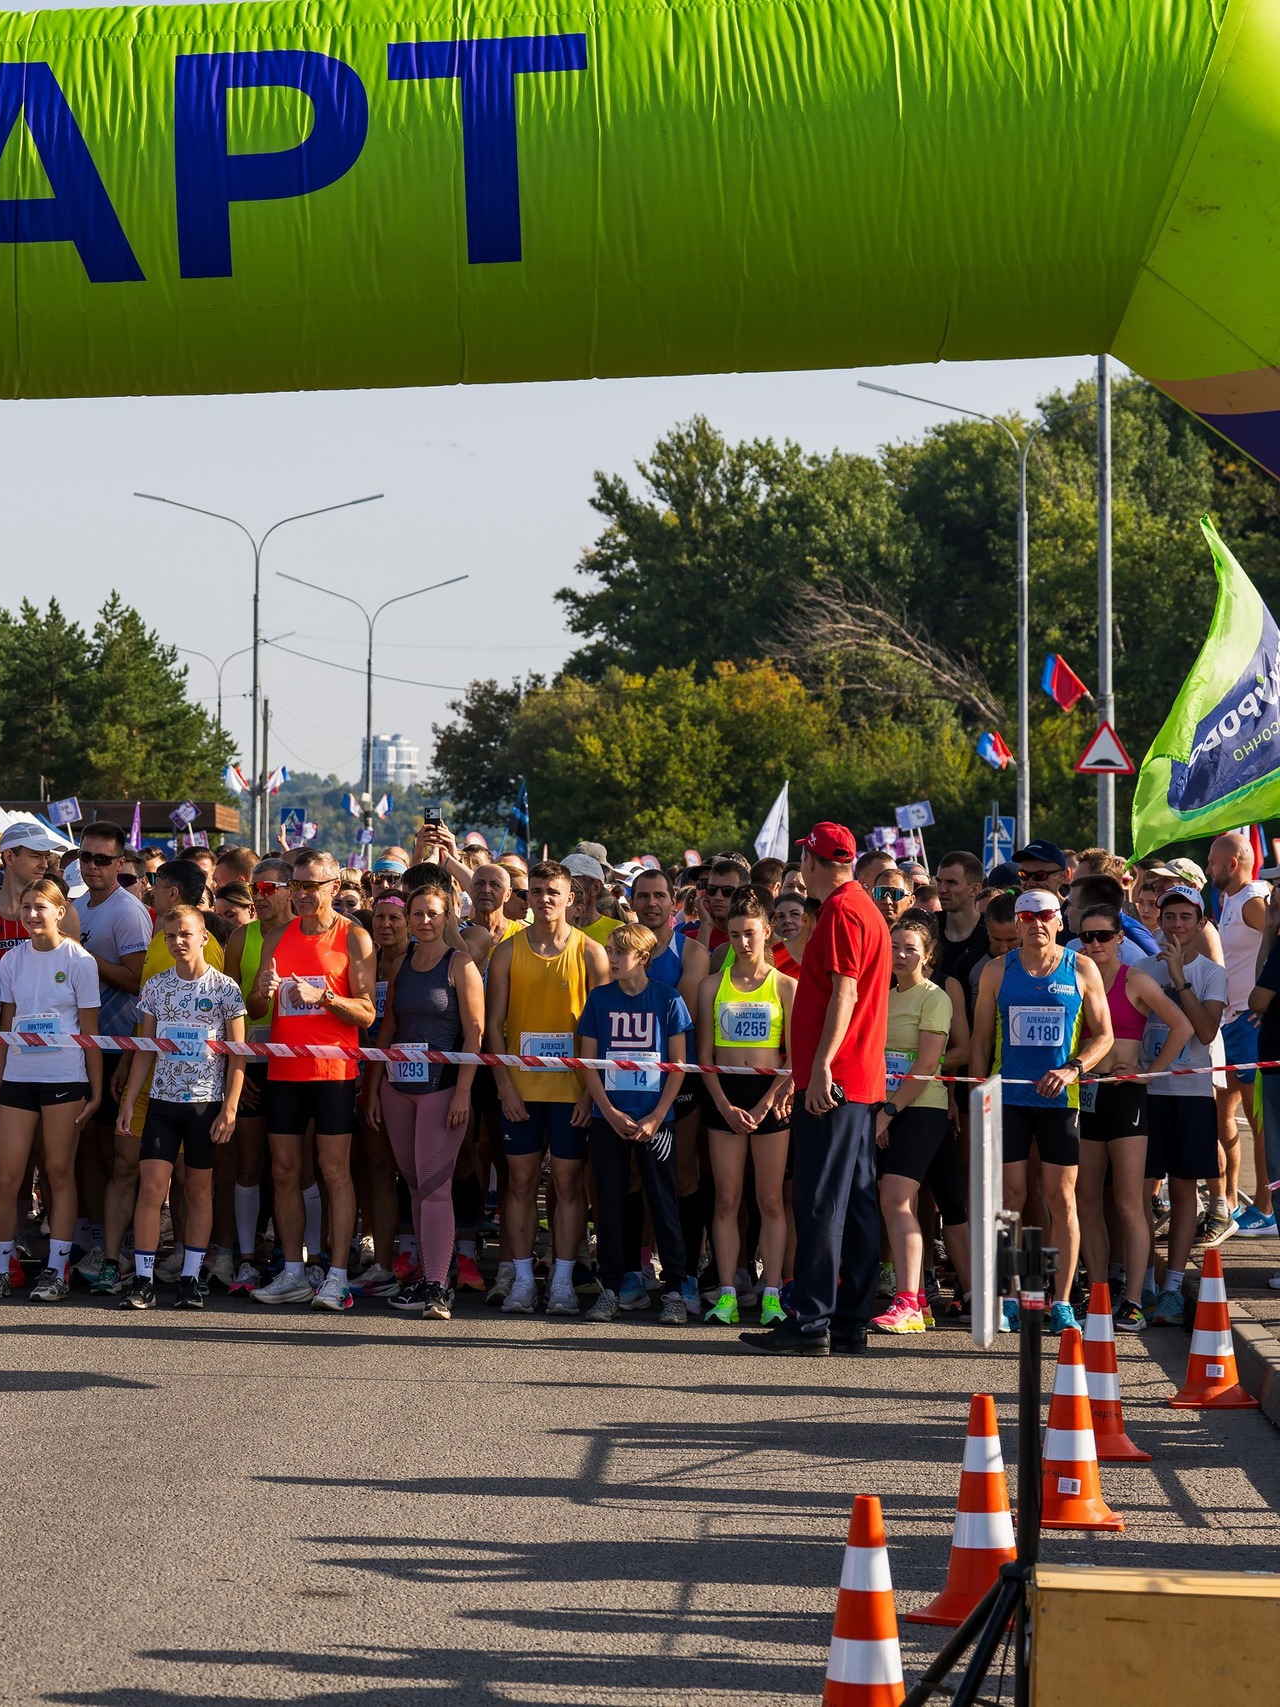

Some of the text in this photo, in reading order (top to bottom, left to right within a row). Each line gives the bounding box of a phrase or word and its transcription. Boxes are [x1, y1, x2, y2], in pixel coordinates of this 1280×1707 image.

[734, 1012, 766, 1020] АНАСТАСИЯ
[1026, 1016, 1061, 1025] АЛЕКСАНДР
[27, 1023, 53, 1032] ВИКТОРИЯ
[609, 1011, 654, 1048] ny
[734, 1021, 767, 1037] 4255
[1027, 1025, 1060, 1042] 4180
[176, 1031, 199, 1040] МАТВЕЙ
[540, 1042, 566, 1051] АЛЕКСЕЙ
[398, 1061, 424, 1078] 1293
[632, 1071, 647, 1087] 14
